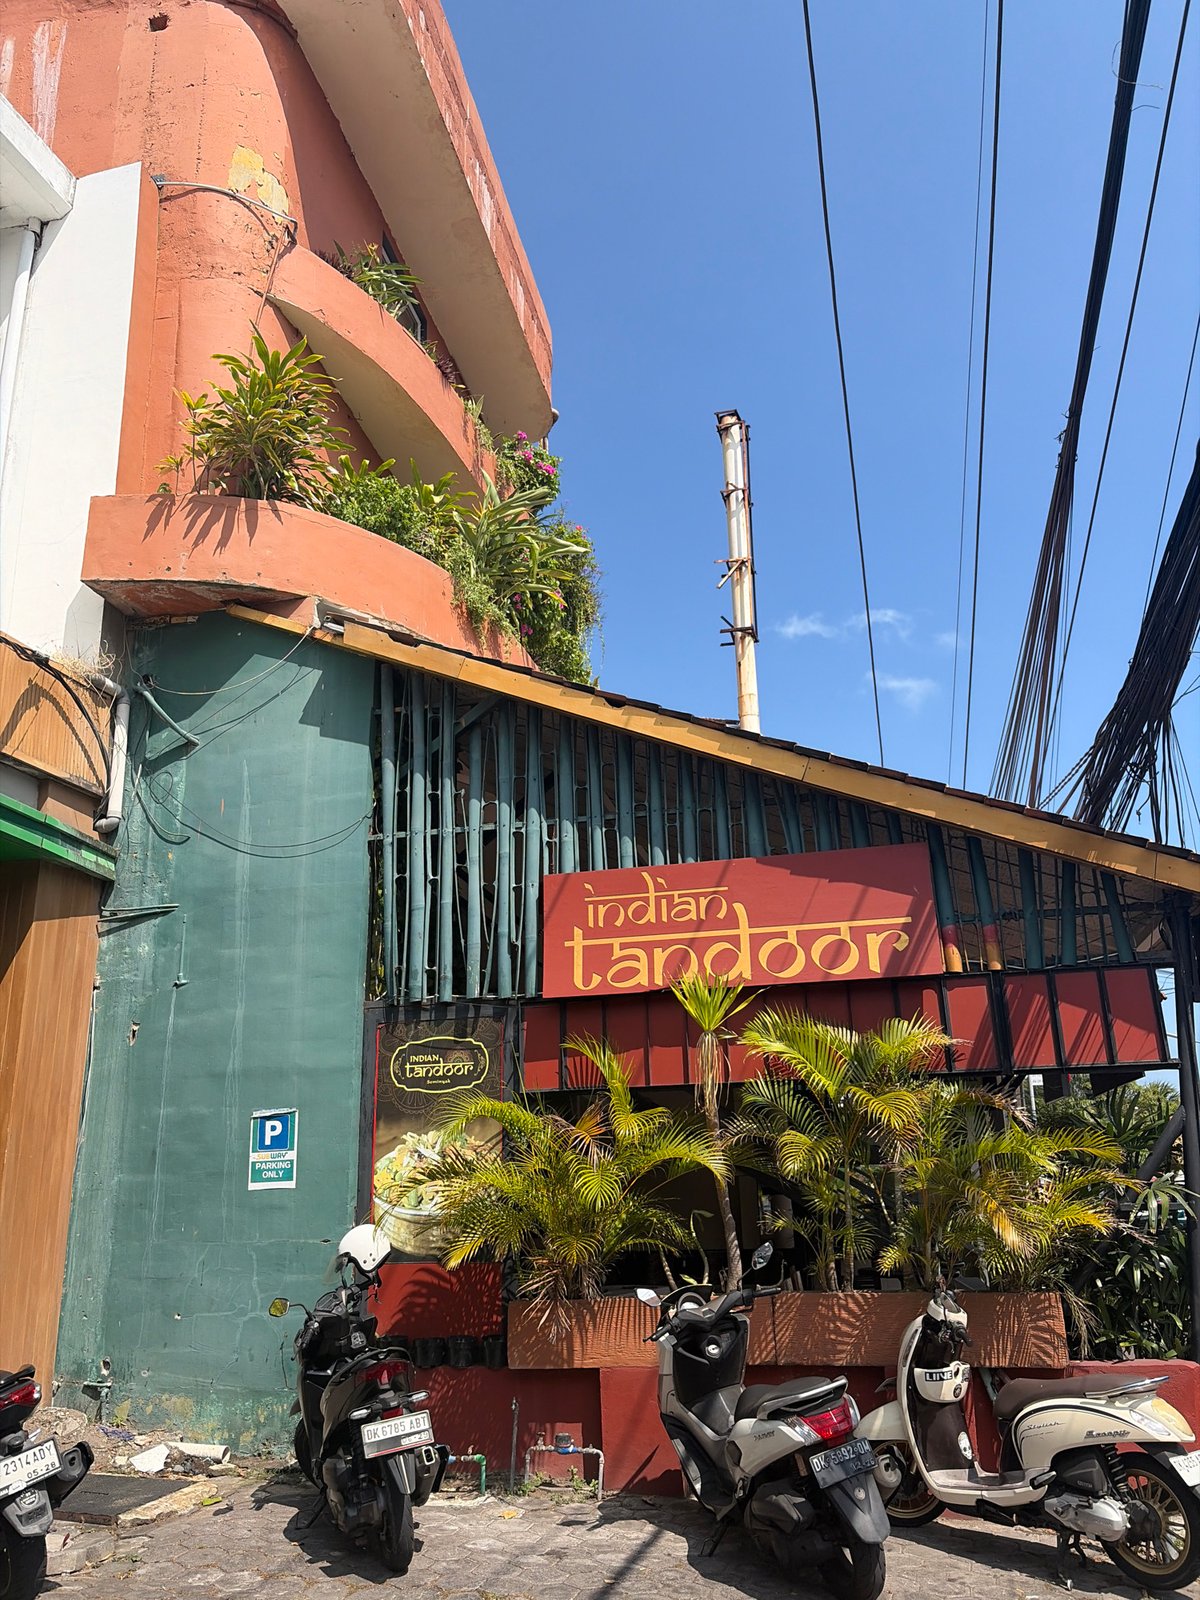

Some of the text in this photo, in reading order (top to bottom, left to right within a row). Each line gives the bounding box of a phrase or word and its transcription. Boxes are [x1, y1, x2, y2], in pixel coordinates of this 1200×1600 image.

[584, 872, 728, 928] indian
[564, 903, 912, 990] tandoor
[405, 1058, 474, 1078] tandoor
[410, 1054, 439, 1063] INDIAN
[265, 1120, 283, 1146] P
[255, 1161, 291, 1170] PARKING
[256, 1152, 288, 1160] SUBWAY
[262, 1170, 284, 1179] ONLY
[366, 1416, 427, 1441] DK 6785 ABT
[812, 1455, 828, 1472] DK
[831, 1446, 856, 1465] 5892
